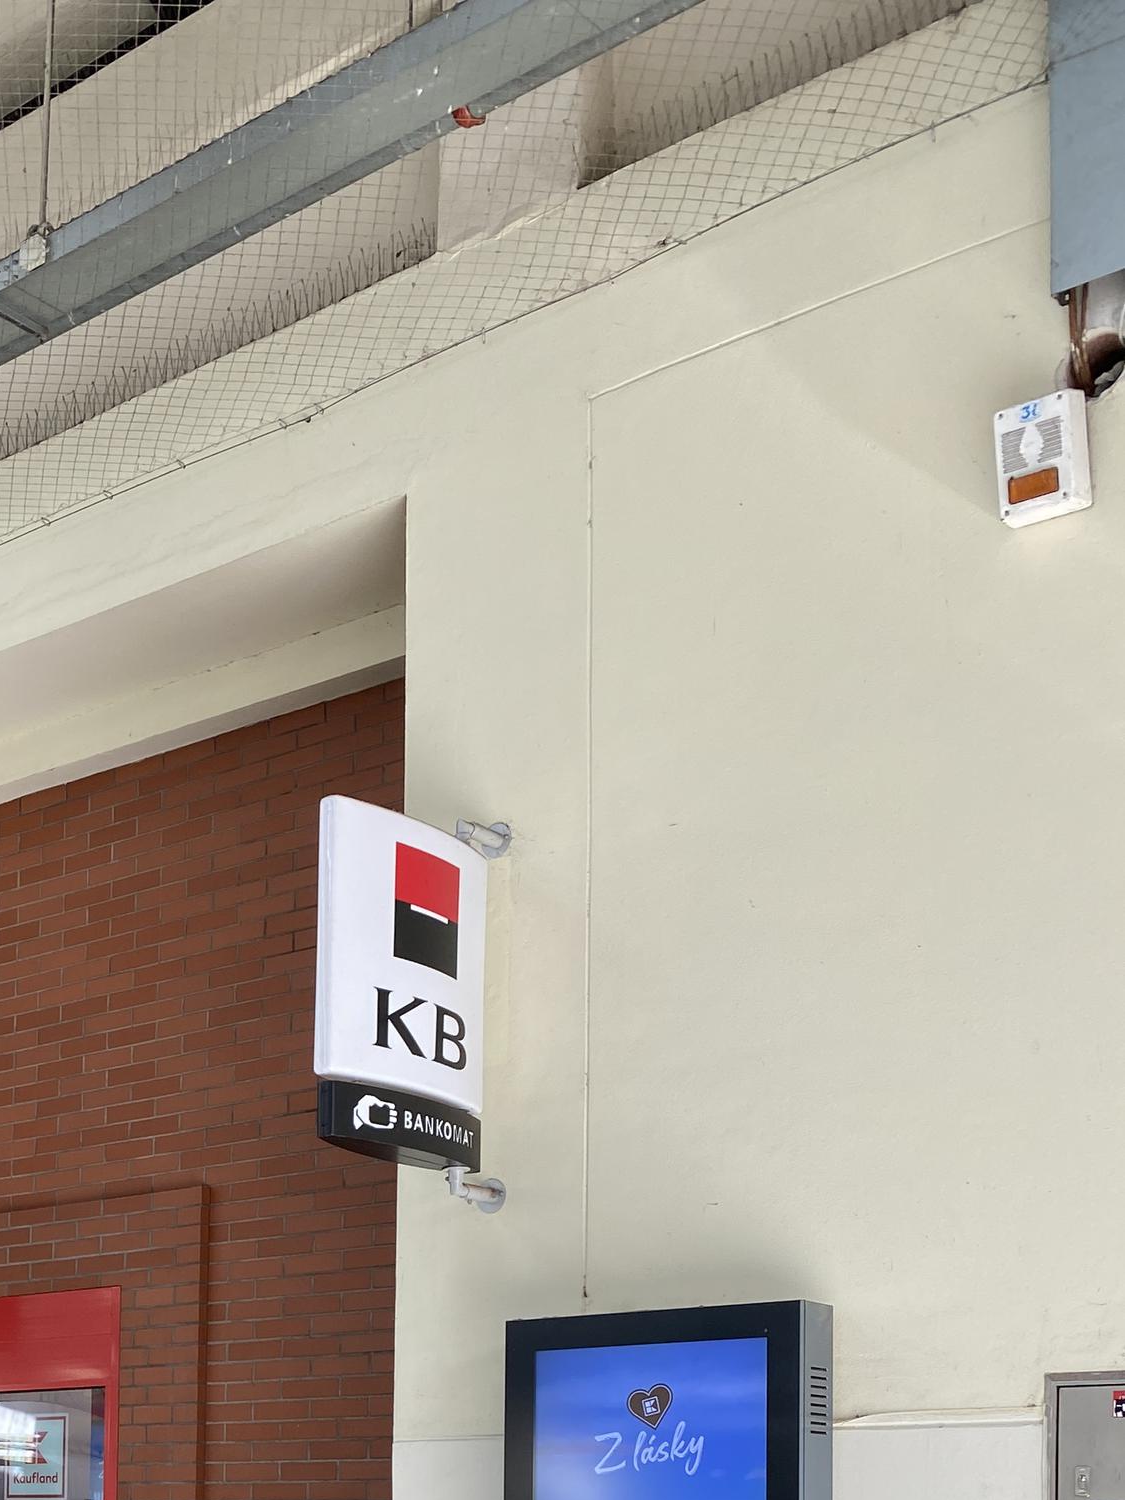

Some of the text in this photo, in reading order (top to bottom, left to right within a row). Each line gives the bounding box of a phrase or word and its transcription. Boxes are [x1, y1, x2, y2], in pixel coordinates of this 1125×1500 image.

[372, 985, 467, 1071] KB
[403, 1110, 475, 1149] BANKOMAT
[594, 1420, 704, 1475] Z lásky
[13, 1472, 59, 1484] Kaufland
